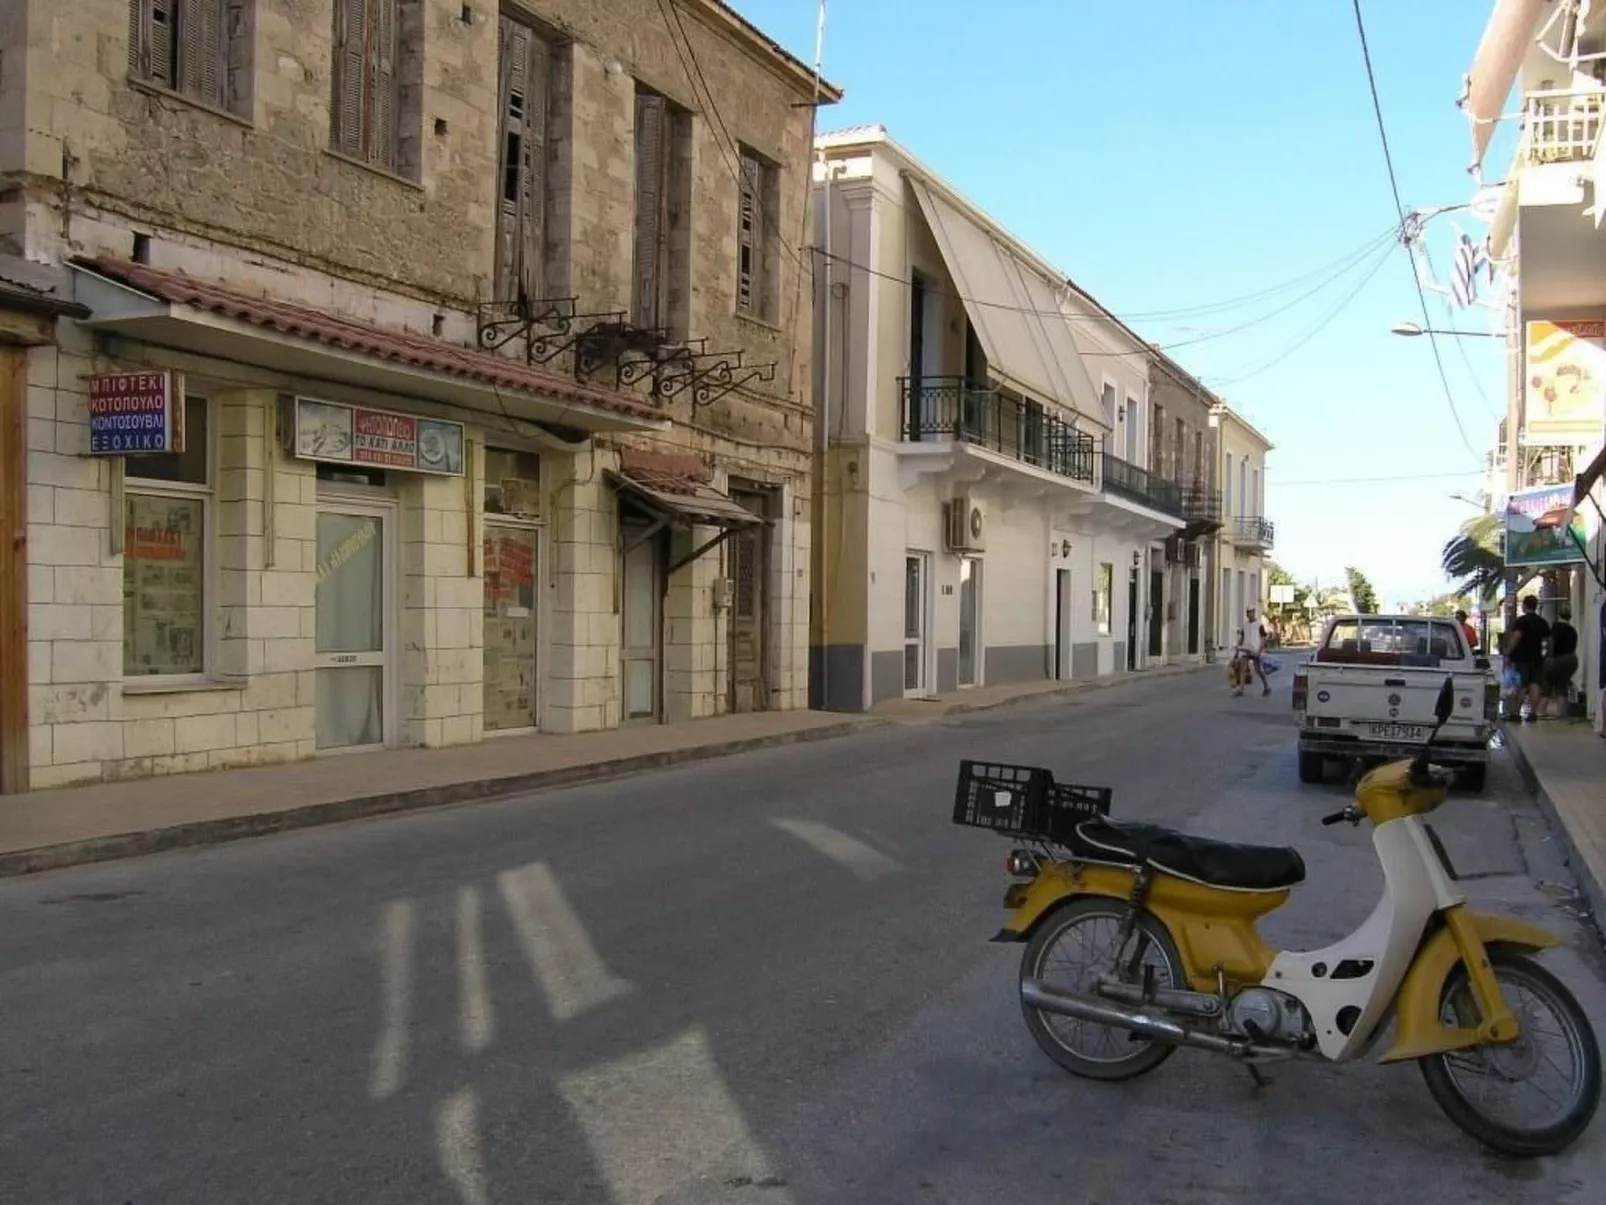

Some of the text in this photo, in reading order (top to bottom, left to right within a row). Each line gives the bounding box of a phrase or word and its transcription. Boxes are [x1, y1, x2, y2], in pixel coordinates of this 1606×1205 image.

[91, 376, 163, 392] ΜΠΙΦΤΕΚΙ
[92, 395, 163, 412] ΚΟΤΟΠΟΥΛΟ
[91, 414, 163, 430] ΚΟΝΤΟΣΟΥΒΛΙ
[92, 434, 163, 450] ΕΞΟΧΙΚΟ
